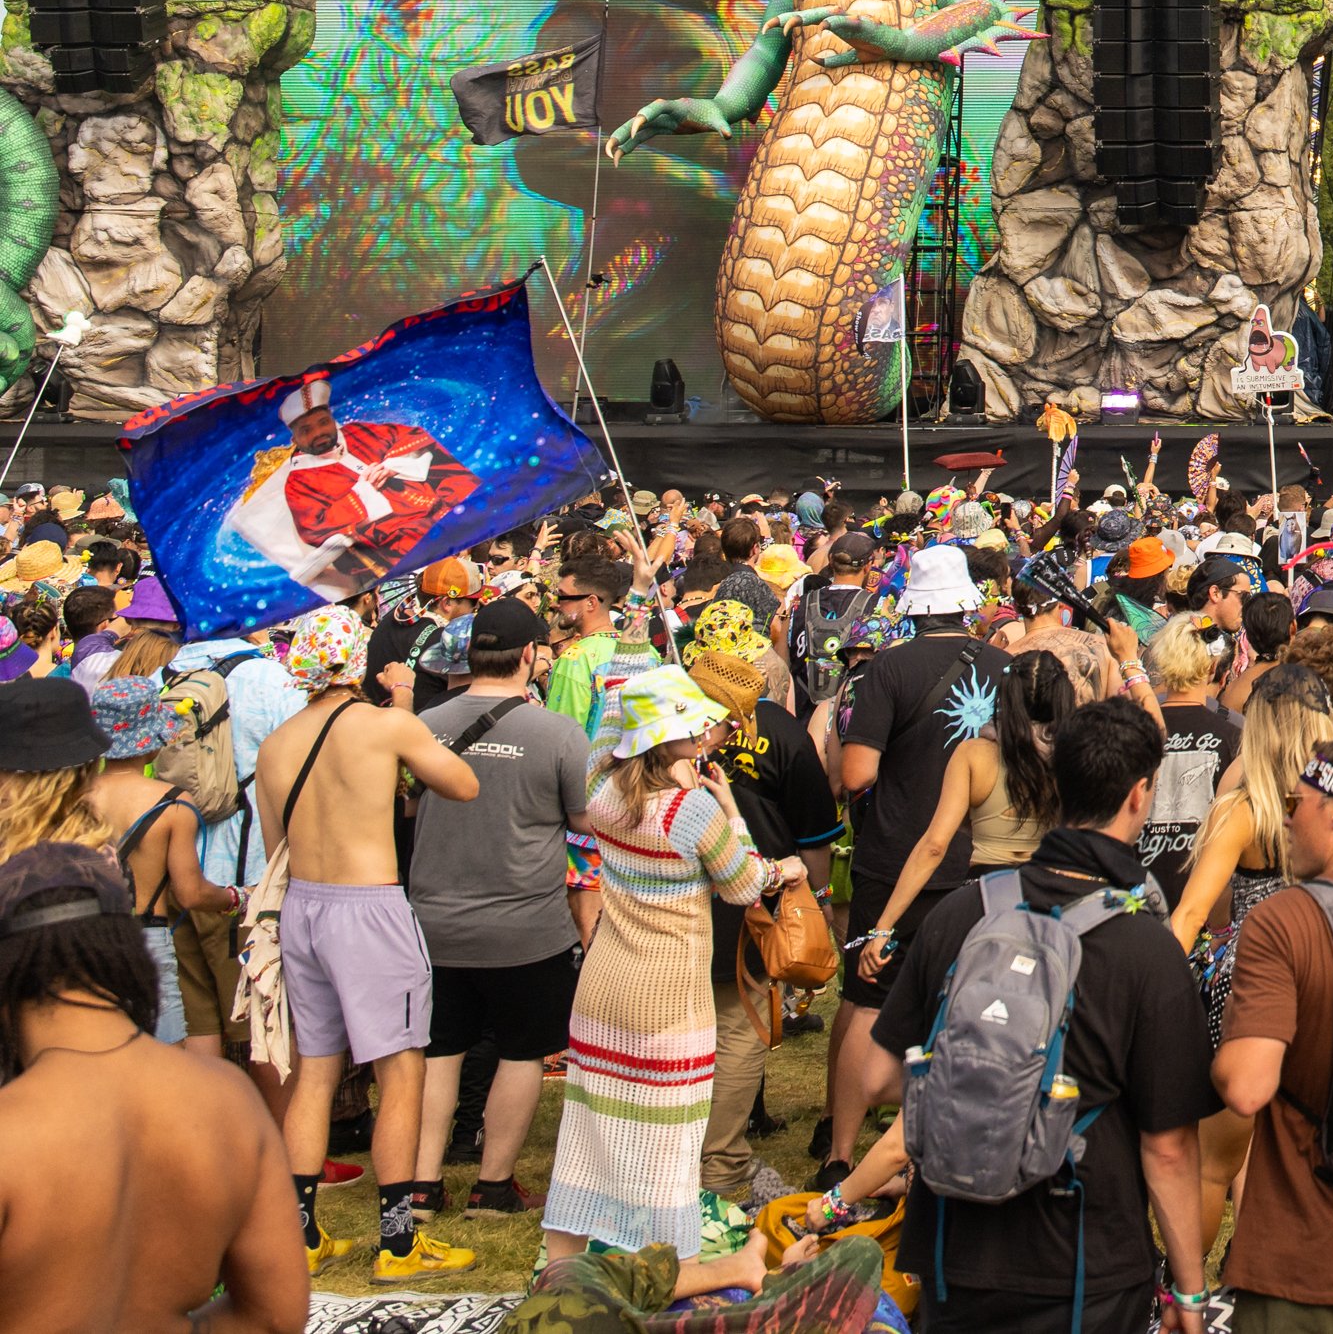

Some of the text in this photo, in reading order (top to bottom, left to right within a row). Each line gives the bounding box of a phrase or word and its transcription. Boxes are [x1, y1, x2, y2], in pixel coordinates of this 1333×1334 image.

[1196, 733, 1223, 754] Go
[1150, 824, 1181, 834] JUST TO
